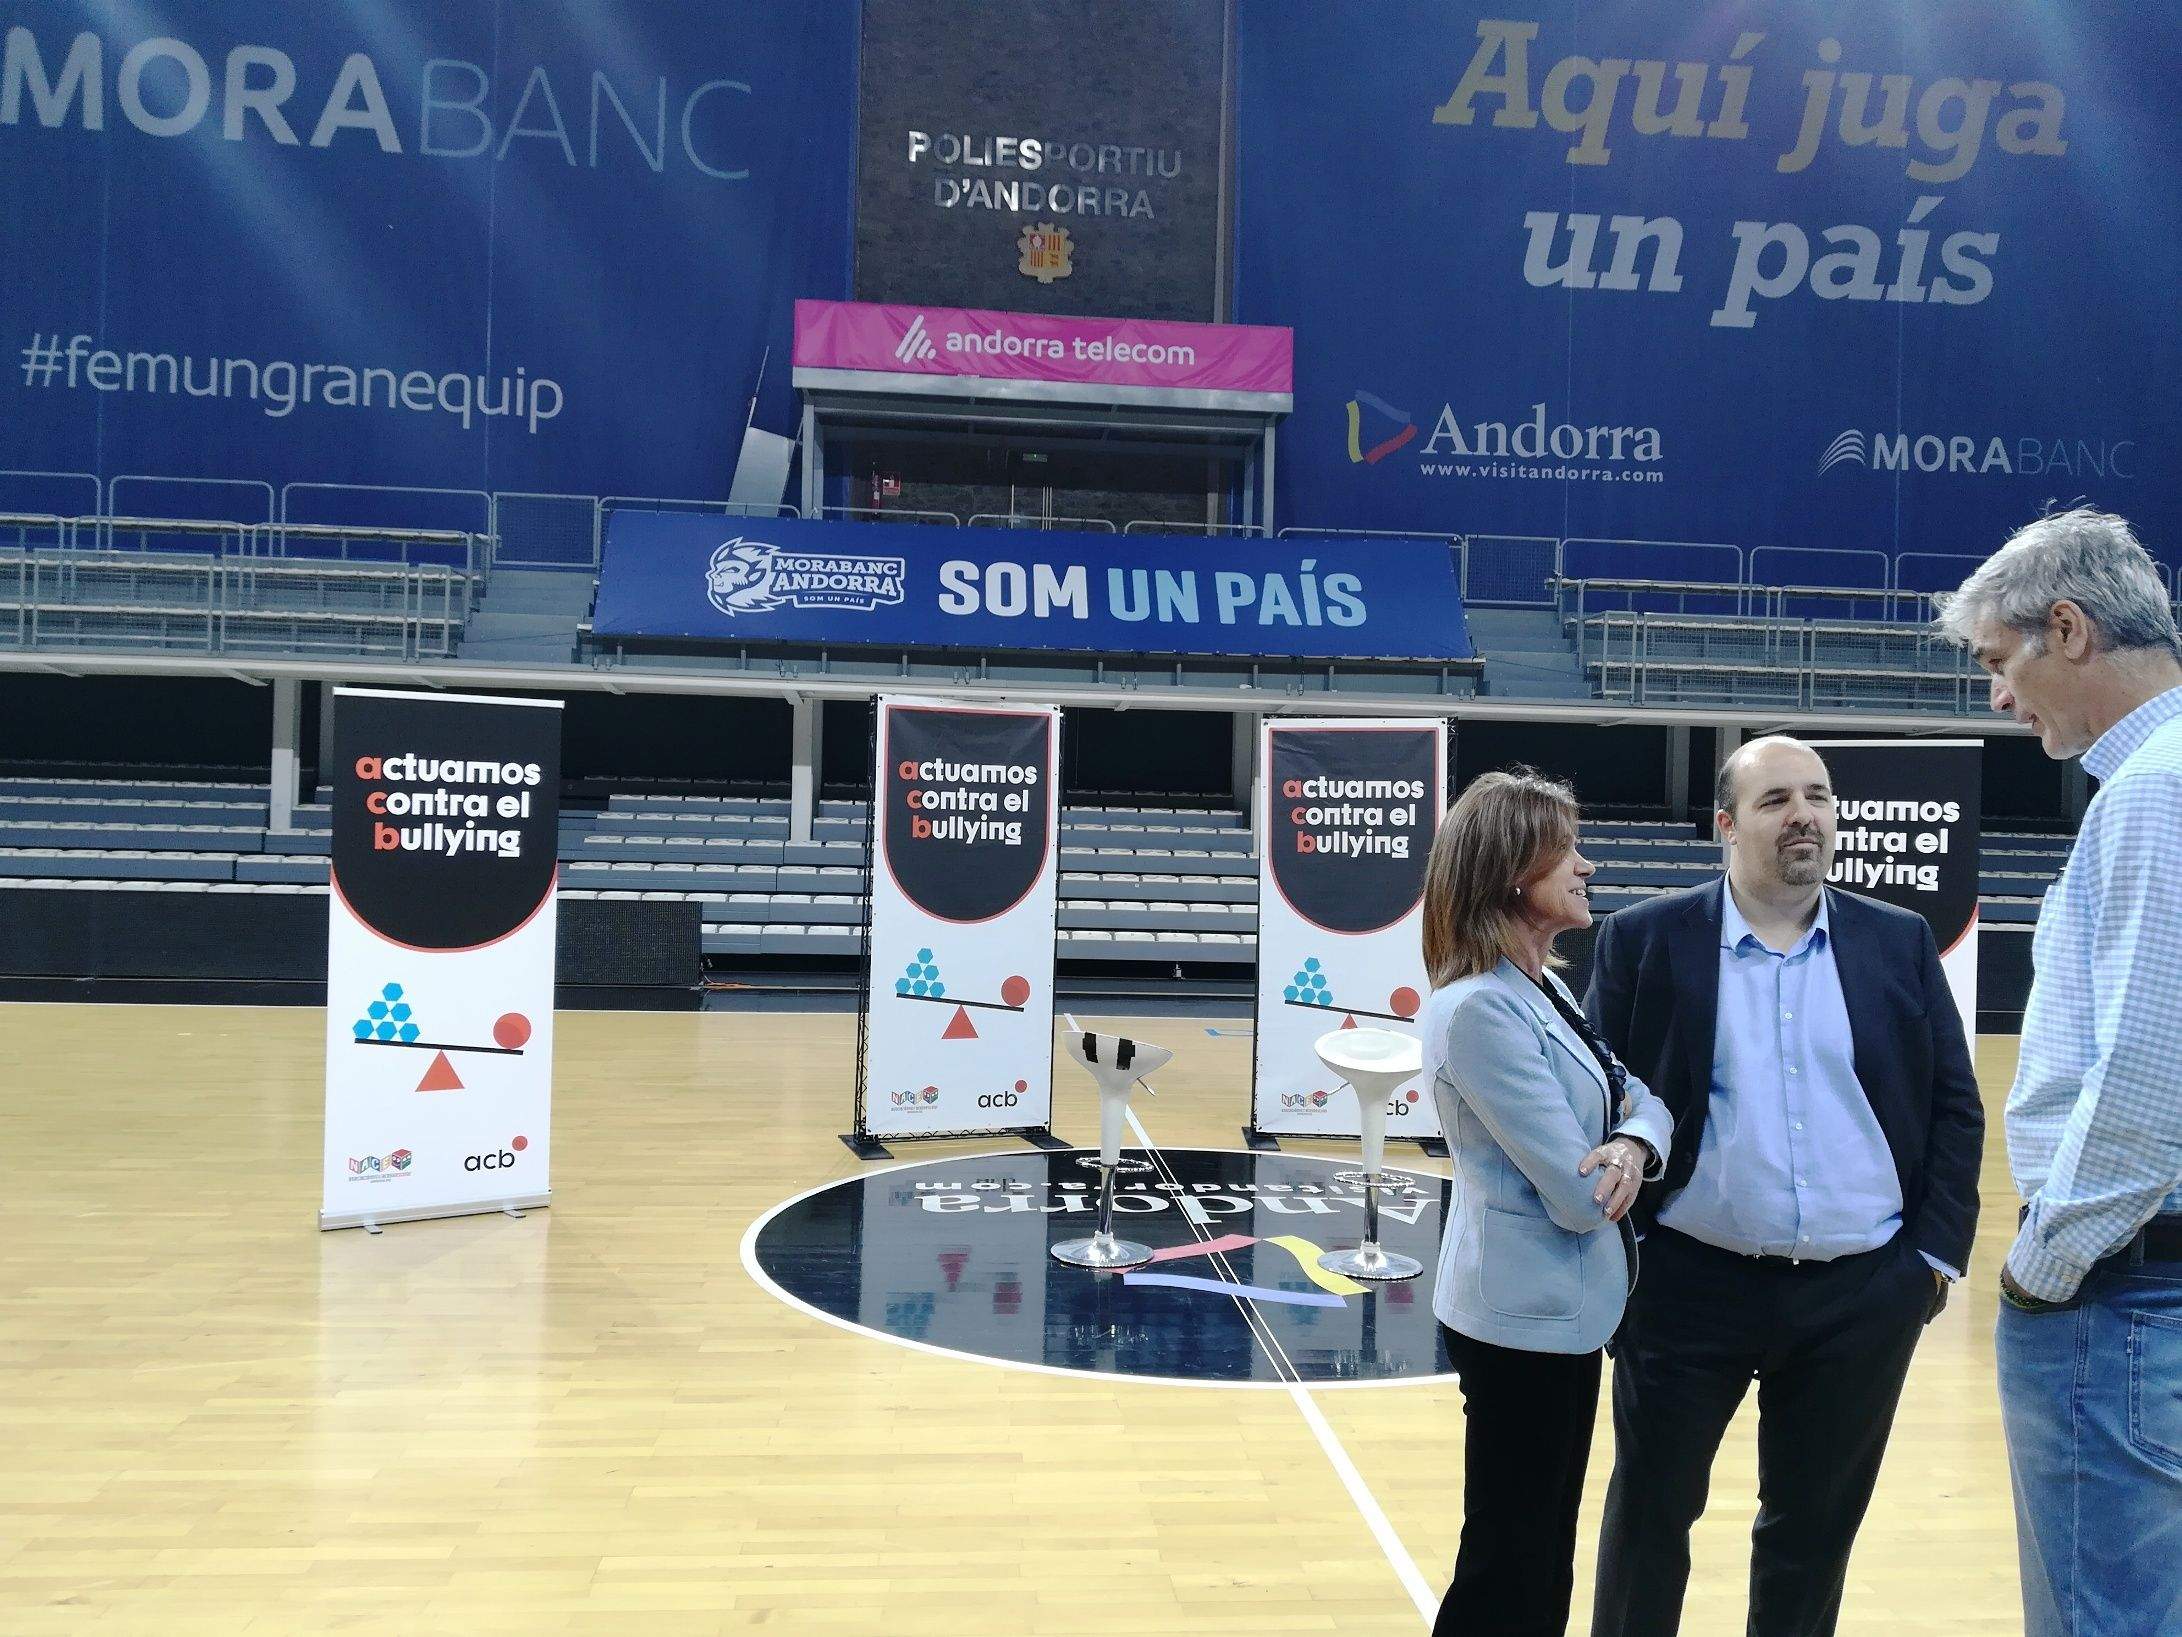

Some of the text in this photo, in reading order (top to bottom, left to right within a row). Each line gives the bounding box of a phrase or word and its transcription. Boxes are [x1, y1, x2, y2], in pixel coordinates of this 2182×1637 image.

[0, 26, 752, 181] MORABANC
[1432, 19, 2069, 183] Aquí juga
[908, 130, 1182, 179] POLIESPORTIU
[1523, 196, 2001, 329] un país
[945, 329, 1196, 365] andorra telecom
[21, 334, 564, 433] #femungranequip
[1419, 402, 1664, 462] Andorra
[1872, 432, 2136, 479] MORABANC
[1419, 461, 1665, 483] www.visitandorra.com
[774, 557, 898, 575] MORABANC
[772, 571, 897, 597] ANDORRA
[803, 595, 824, 603] SOM
[938, 558, 1368, 627] SOM UN PAÍS
[355, 753, 542, 786] actuamos
[898, 757, 1038, 785] actuamos
[906, 787, 1029, 812] contra el
[1282, 776, 1425, 799] actuamos
[366, 788, 530, 818] contra el
[1290, 803, 1416, 826] contra el
[1832, 795, 1961, 823] tuamos
[374, 820, 521, 858] bullying
[912, 814, 1022, 845] bullying
[1296, 828, 1410, 858] bullying
[1835, 826, 1949, 854] ntra el
[1825, 856, 1939, 891] ullying
[977, 1090, 1018, 1108] acb
[1386, 1099, 1410, 1116] cb
[464, 1149, 515, 1172] acb
[914, 1194, 1441, 1225] Andorra
